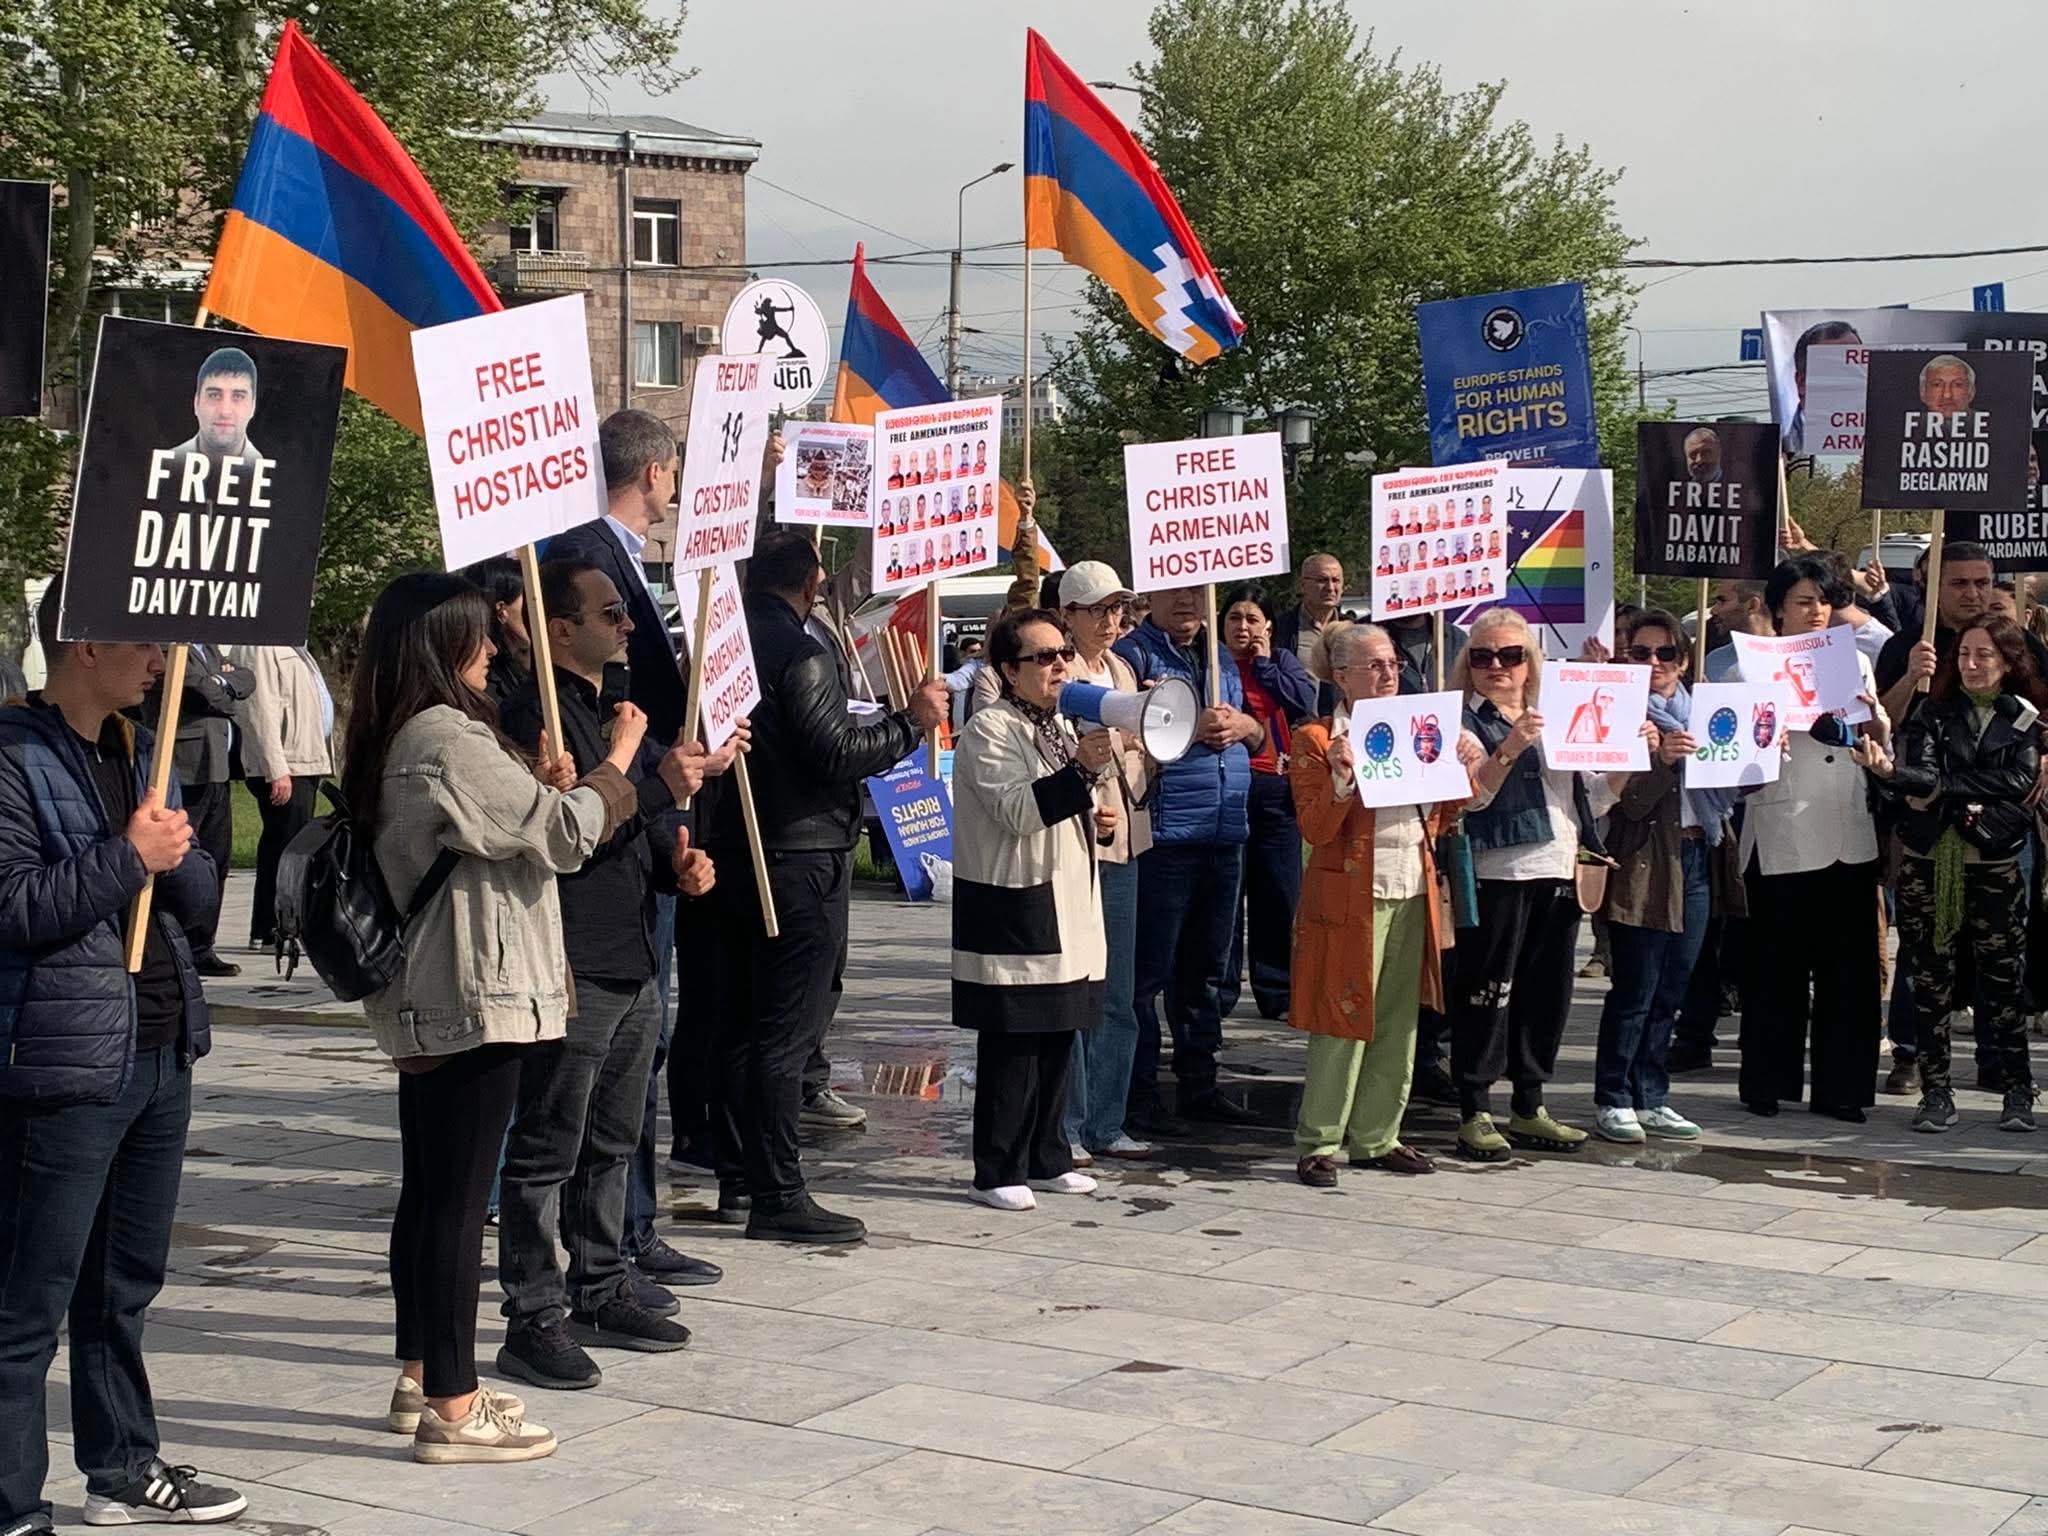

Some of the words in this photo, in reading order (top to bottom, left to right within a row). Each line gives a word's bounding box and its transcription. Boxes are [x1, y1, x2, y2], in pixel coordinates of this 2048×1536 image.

[475, 352, 545, 402] FREE
[1453, 372, 1506, 390] EUROPE
[1508, 364, 1563, 382] STANDS
[1455, 393, 1492, 410] FOR
[1496, 380, 1565, 404] HUMAN
[448, 395, 580, 465] CHRISTIAN
[890, 431, 907, 444] FREE
[910, 427, 948, 441] ARMENIAN
[949, 420, 989, 435] PRISONERS
[1457, 402, 1568, 440] RIGHTS
[1831, 412, 1864, 428] CRI
[1904, 411, 1990, 438] FREE
[721, 411, 743, 463] 19
[1823, 435, 1866, 449] ARM
[1176, 449, 1236, 475] FREE
[1485, 448, 1532, 461] PROVE
[1533, 446, 1547, 458] IT
[1901, 441, 1989, 468] RASHID
[147, 449, 277, 508] FREE
[454, 446, 588, 520] HOSTAGES
[1388, 491, 1406, 500] FREE
[1409, 485, 1450, 498] ARMENIAN
[1451, 480, 1494, 491] PRISONERS
[1900, 472, 1988, 491] BEGLARYAN
[1146, 477, 1269, 512] CHRISTIAN
[1668, 481, 1742, 509] FREE
[134, 510, 270, 573] DAVIT
[1149, 510, 1270, 546] ARMENIAN
[1668, 513, 1742, 544] DAVIT
[1149, 541, 1274, 578] HOSTAGES
[1665, 543, 1740, 565] BABAYAN
[1979, 541, 2048, 558] ARDANYA
[128, 576, 261, 618] DAVTYAN
[696, 586, 738, 639] RISTIAN
[703, 626, 747, 690] ARMENIAN
[709, 665, 754, 732] HOSTAGES
[1752, 702, 1776, 722] NO
[1411, 714, 1439, 736] NO
[1709, 742, 1740, 762] YES
[1369, 757, 1403, 780] YES
[891, 796, 942, 824] RIGHTS
[928, 815, 946, 829] FOR
[897, 819, 929, 838] HUMAN
